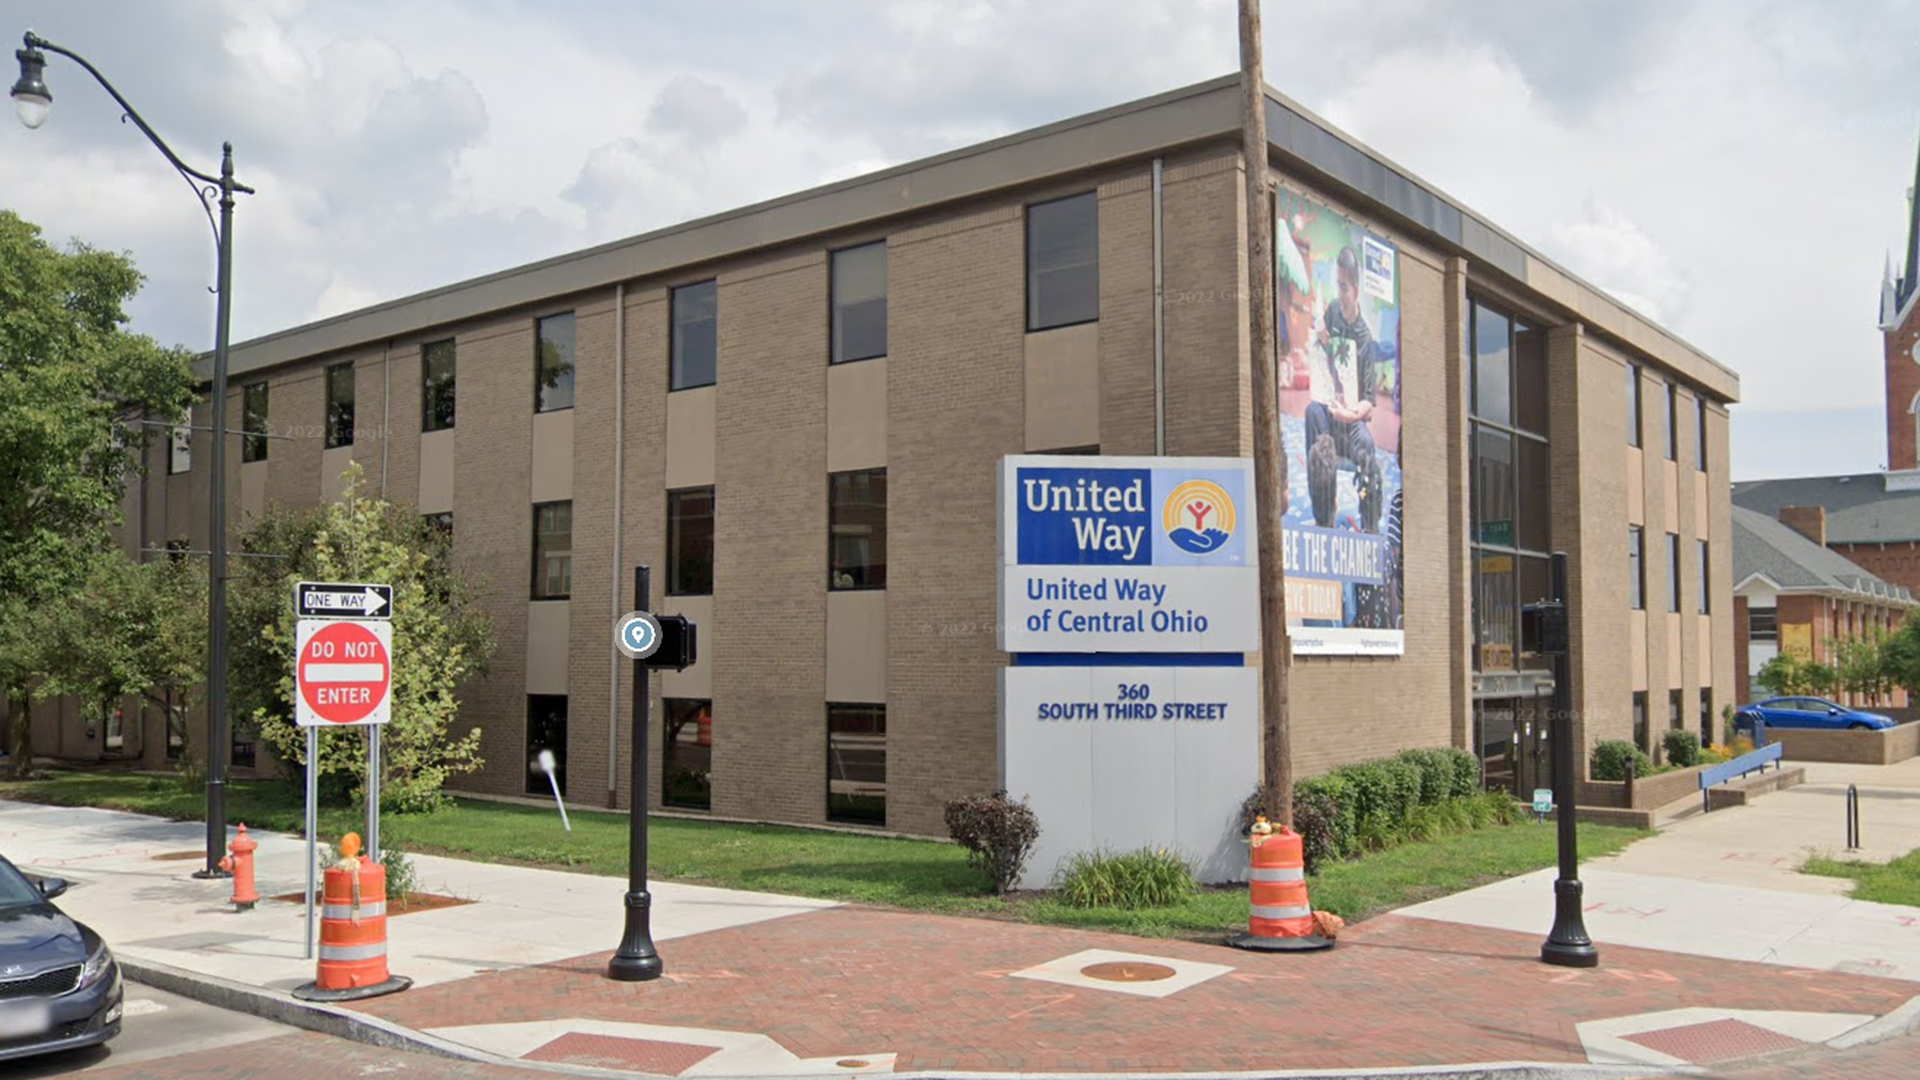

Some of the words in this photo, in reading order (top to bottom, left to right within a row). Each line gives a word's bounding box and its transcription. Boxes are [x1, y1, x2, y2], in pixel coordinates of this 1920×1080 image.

[1023, 478, 1146, 513] United
[1072, 517, 1146, 561] Way
[1282, 528, 1299, 571] BE
[1302, 531, 1328, 574] THE
[306, 594, 332, 607] ONE
[340, 594, 366, 607] WAY
[1026, 577, 1107, 601] United
[1114, 578, 1167, 606] Way
[1026, 609, 1053, 632] of
[1058, 609, 1145, 633] Central
[1151, 610, 1209, 633] Ohio
[311, 641, 335, 659] DO
[344, 641, 378, 659] NOT
[317, 687, 372, 705] ENTER
[1117, 684, 1150, 701] 360
[1037, 703, 1099, 721] SOUTH
[1104, 703, 1158, 720] THIRD
[1162, 703, 1228, 721] STREET
